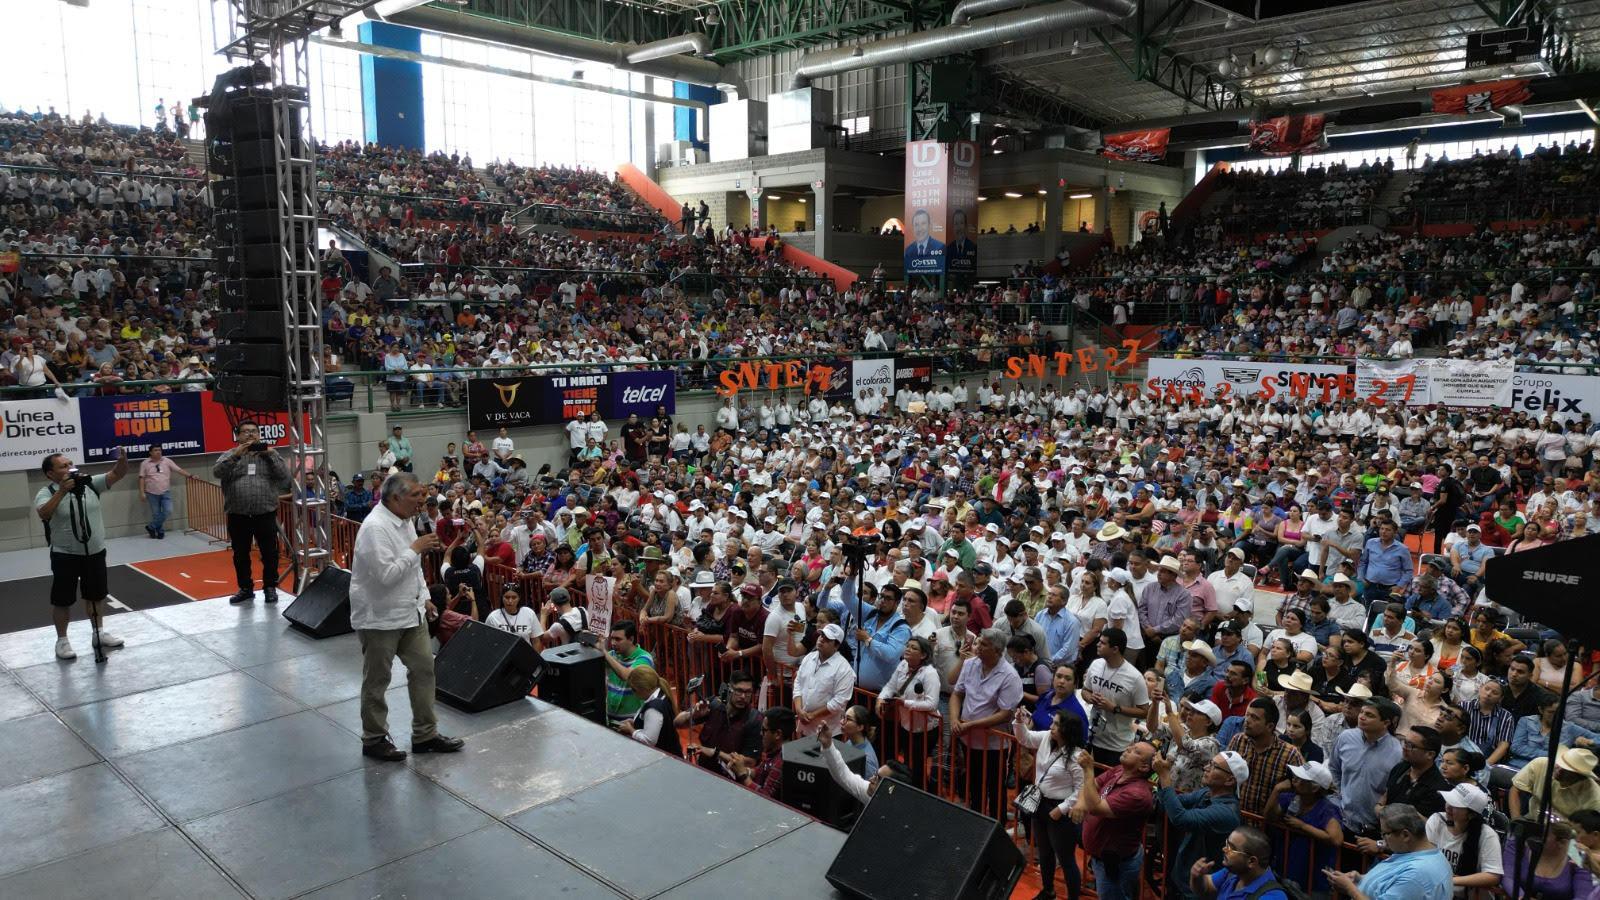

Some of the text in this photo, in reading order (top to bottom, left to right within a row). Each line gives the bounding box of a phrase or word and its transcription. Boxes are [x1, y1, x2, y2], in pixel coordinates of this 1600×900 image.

[1468, 60, 1487, 68] LOCAL
[552, 376, 608, 388] TU MARCA
[855, 378, 862, 386] el
[862, 376, 891, 386] colorado
[1512, 375, 1553, 389] Grupo
[563, 387, 598, 399] TIENE
[622, 384, 667, 404] telcel
[113, 398, 169, 412] TIENES
[1511, 388, 1582, 413] Félix
[5, 410, 54, 423] Línea
[494, 412, 507, 421] DE
[510, 411, 531, 420] VACA
[6, 421, 75, 438] Directa
[114, 411, 172, 437] AQUÍ
[88, 448, 103, 456] EN
[161, 440, 201, 450] OFICIAL
[1522, 570, 1580, 585] SHURE
[499, 624, 528, 633] STAFF
[1092, 675, 1124, 693] STAFF
[797, 770, 816, 784] 06
